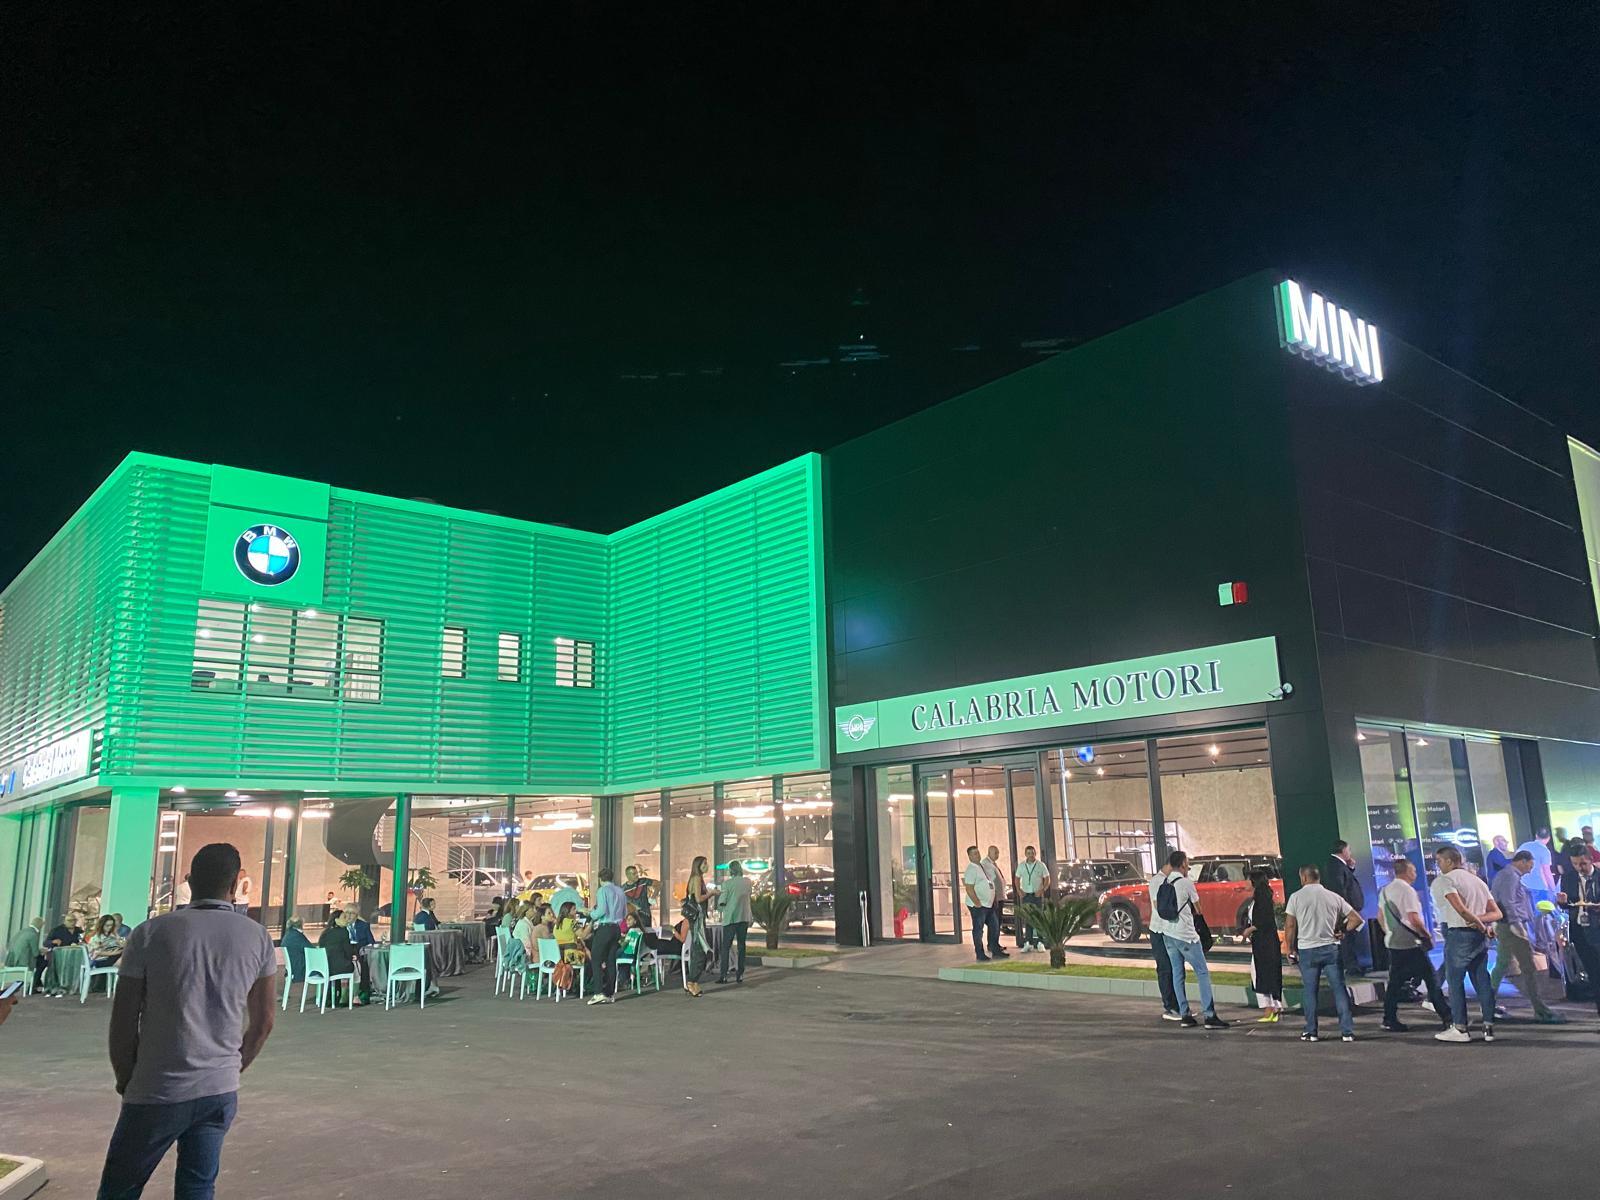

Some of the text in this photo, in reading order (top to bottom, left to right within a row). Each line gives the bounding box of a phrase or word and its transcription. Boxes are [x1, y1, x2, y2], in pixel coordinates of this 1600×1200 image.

[1281, 279, 1383, 383] MINI
[242, 525, 297, 549] BMW
[911, 659, 1224, 732] CALABRIA MOTORI
